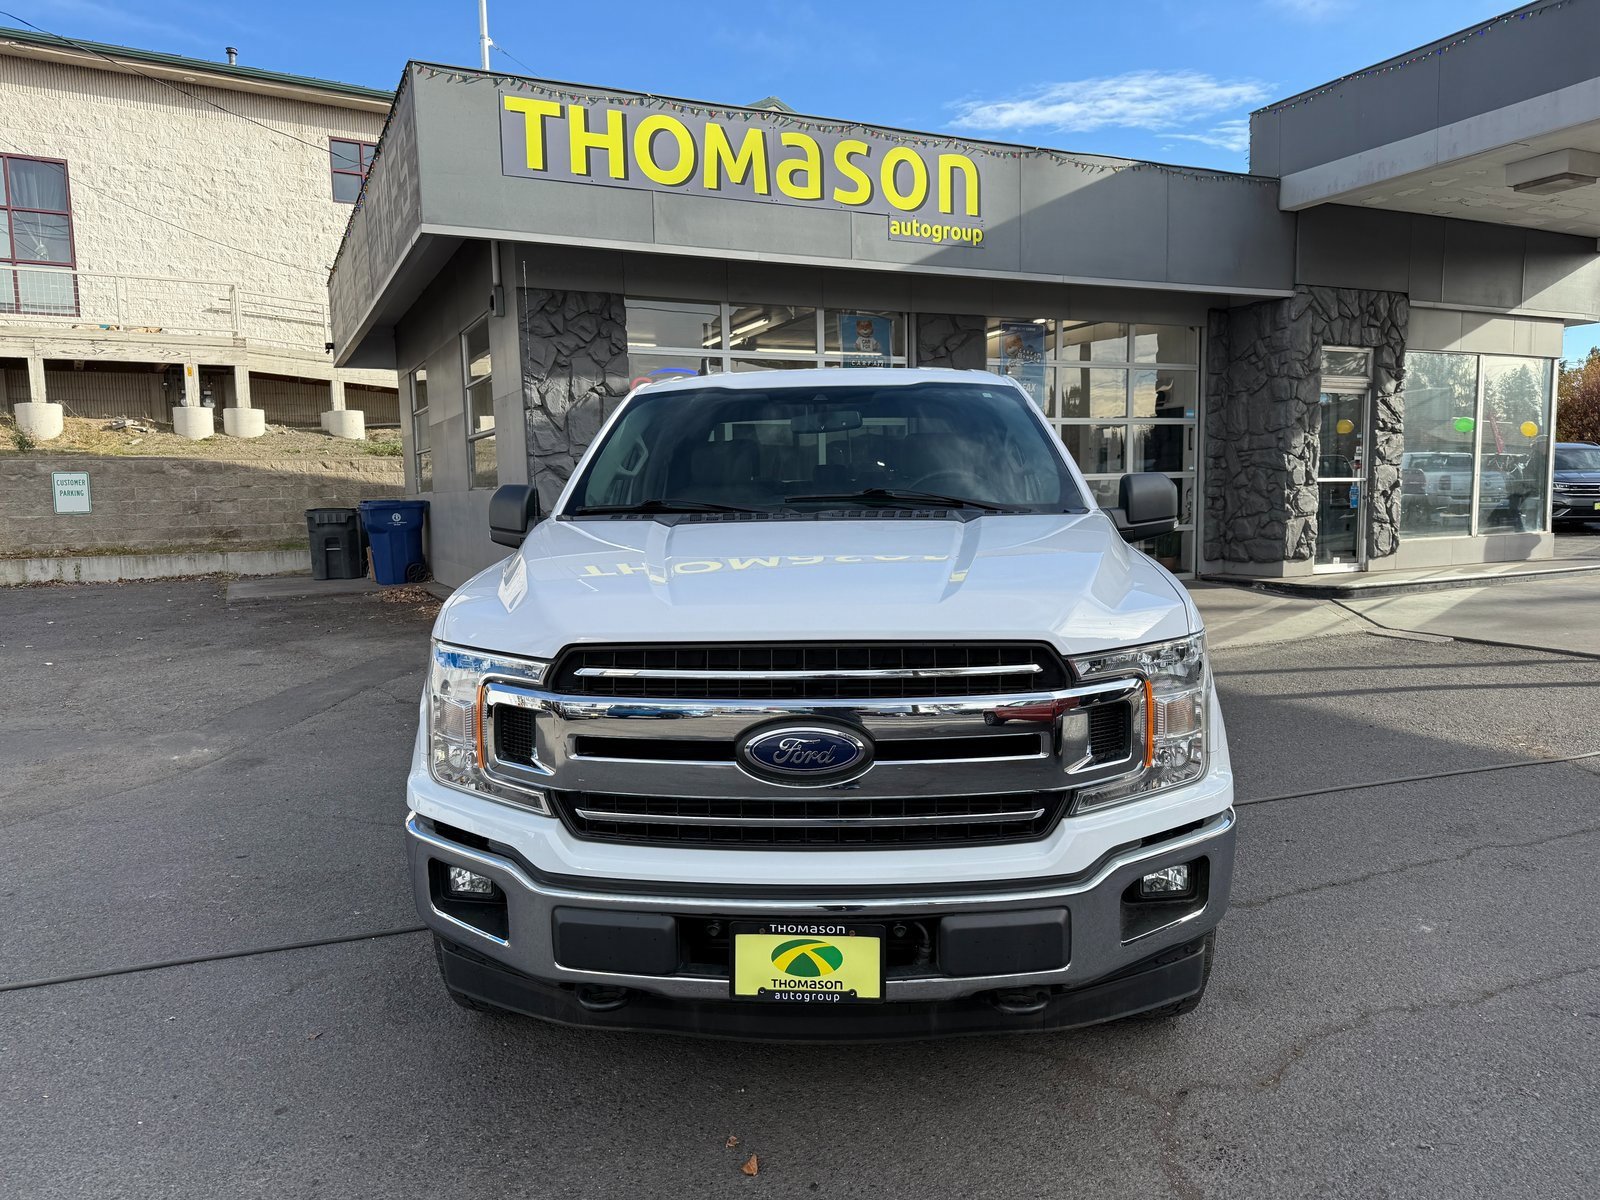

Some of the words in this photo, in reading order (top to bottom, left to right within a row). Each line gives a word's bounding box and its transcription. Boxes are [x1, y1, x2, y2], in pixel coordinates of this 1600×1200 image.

[503, 95, 980, 217] THOMason
[889, 218, 984, 246] autogroup
[59, 489, 84, 497] PARKING
[772, 737, 837, 765] Ford
[769, 924, 846, 934] THOMason
[771, 978, 843, 990] THOMason
[774, 991, 840, 1003] autogroup
